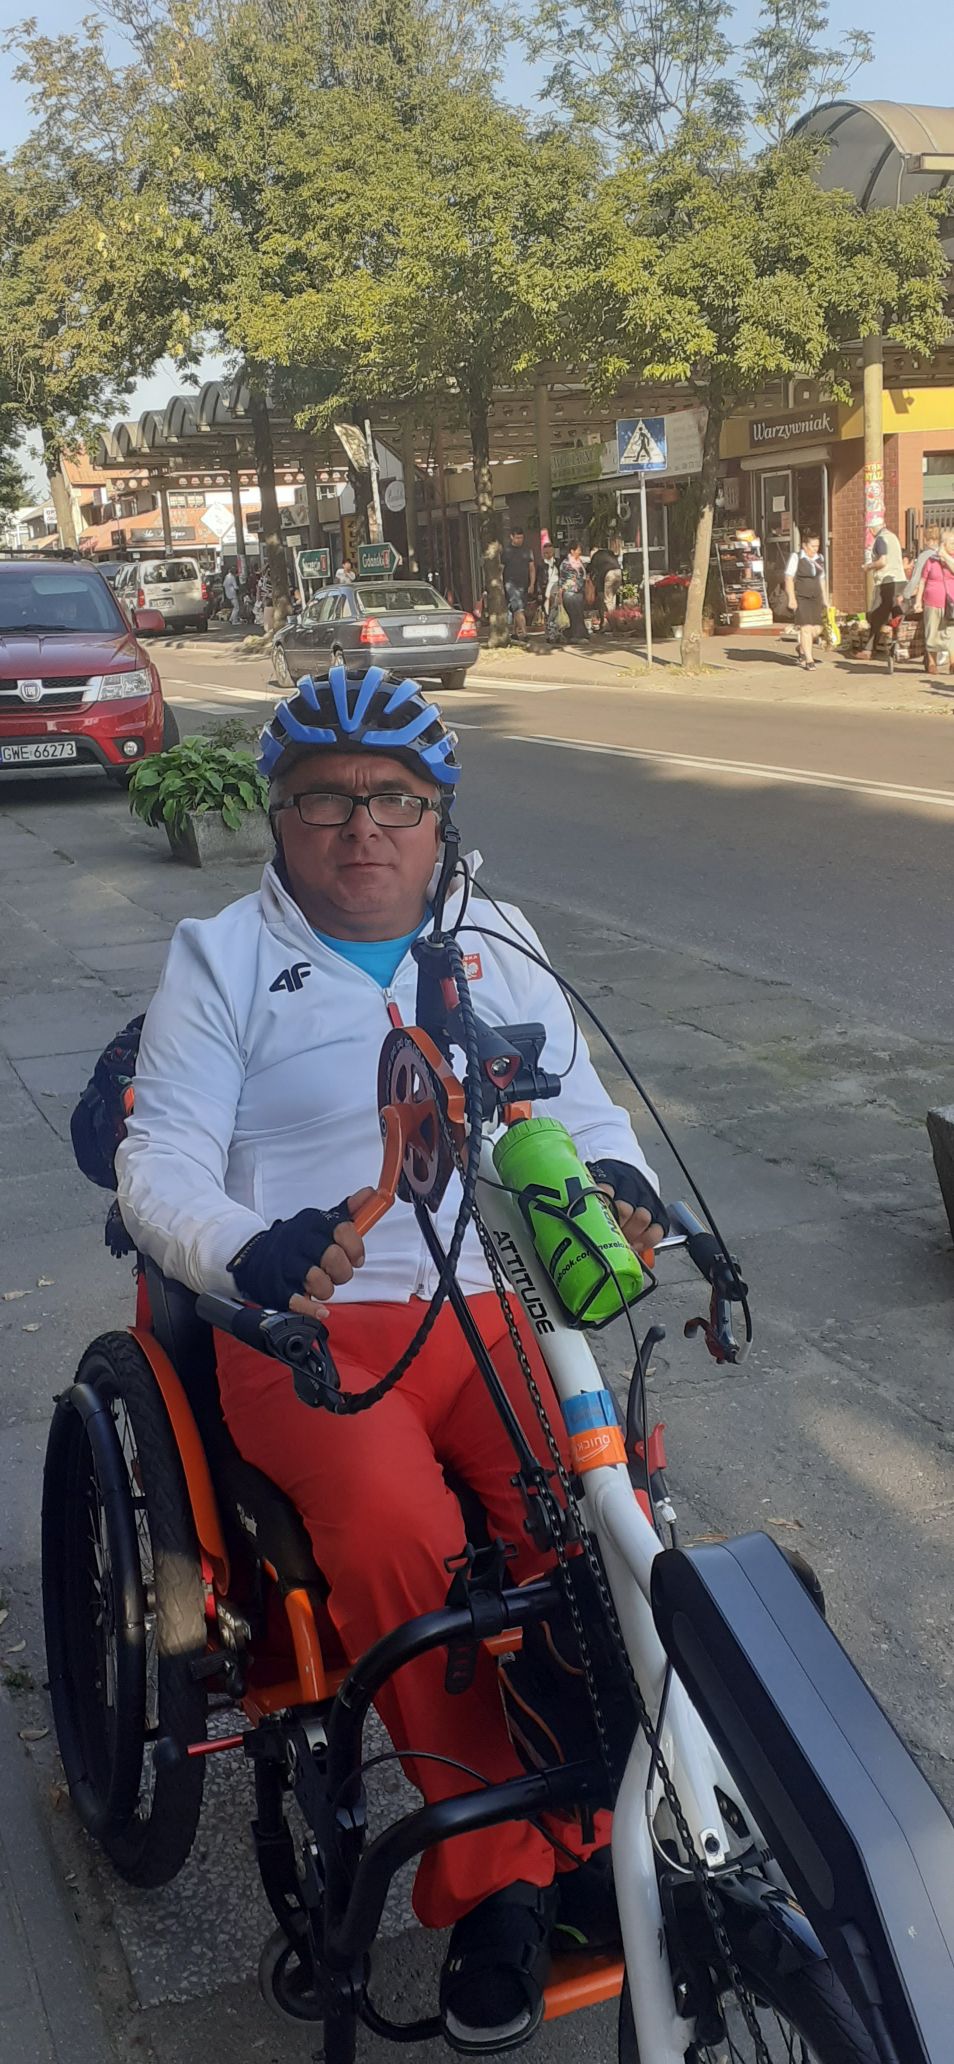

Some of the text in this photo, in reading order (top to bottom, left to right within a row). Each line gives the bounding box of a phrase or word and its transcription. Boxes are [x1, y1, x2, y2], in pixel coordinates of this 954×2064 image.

[753, 412, 834, 440] Warzywniak
[3, 742, 75, 761] GWE 66273
[269, 962, 312, 992] 4F
[493, 1231, 555, 1335] ATTITUDE
[576, 1434, 611, 1451] QUICK
